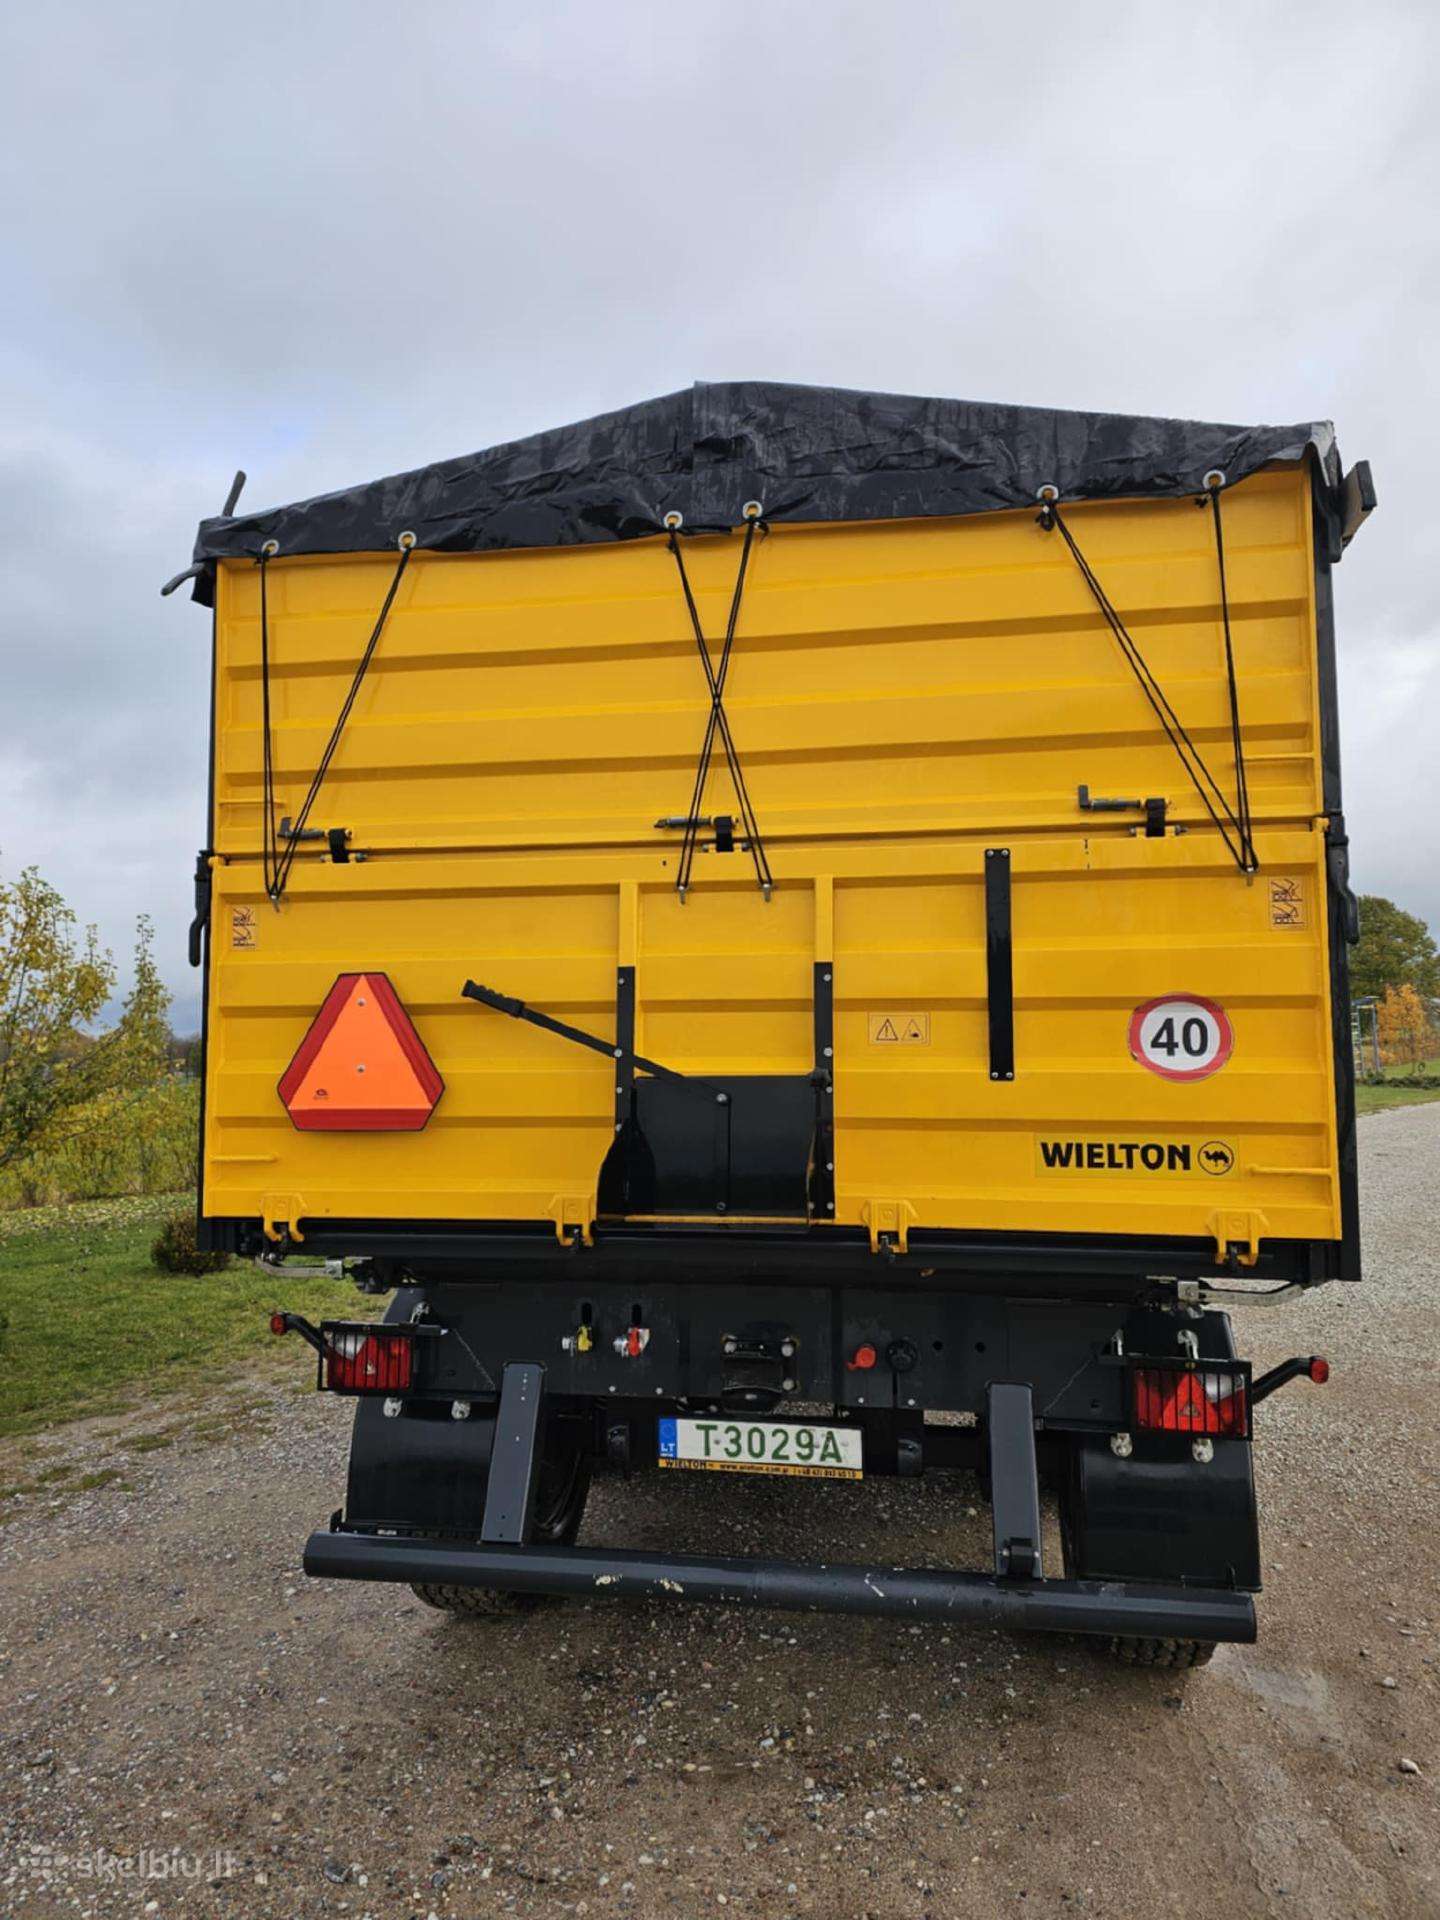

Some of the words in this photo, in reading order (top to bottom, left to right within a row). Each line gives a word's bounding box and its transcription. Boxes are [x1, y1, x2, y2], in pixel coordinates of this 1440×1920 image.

[1150, 1017, 1209, 1057] 40
[1040, 1142, 1191, 1171] WIELTON
[661, 1442, 676, 1452] LT
[695, 1424, 842, 1463] T3029A
